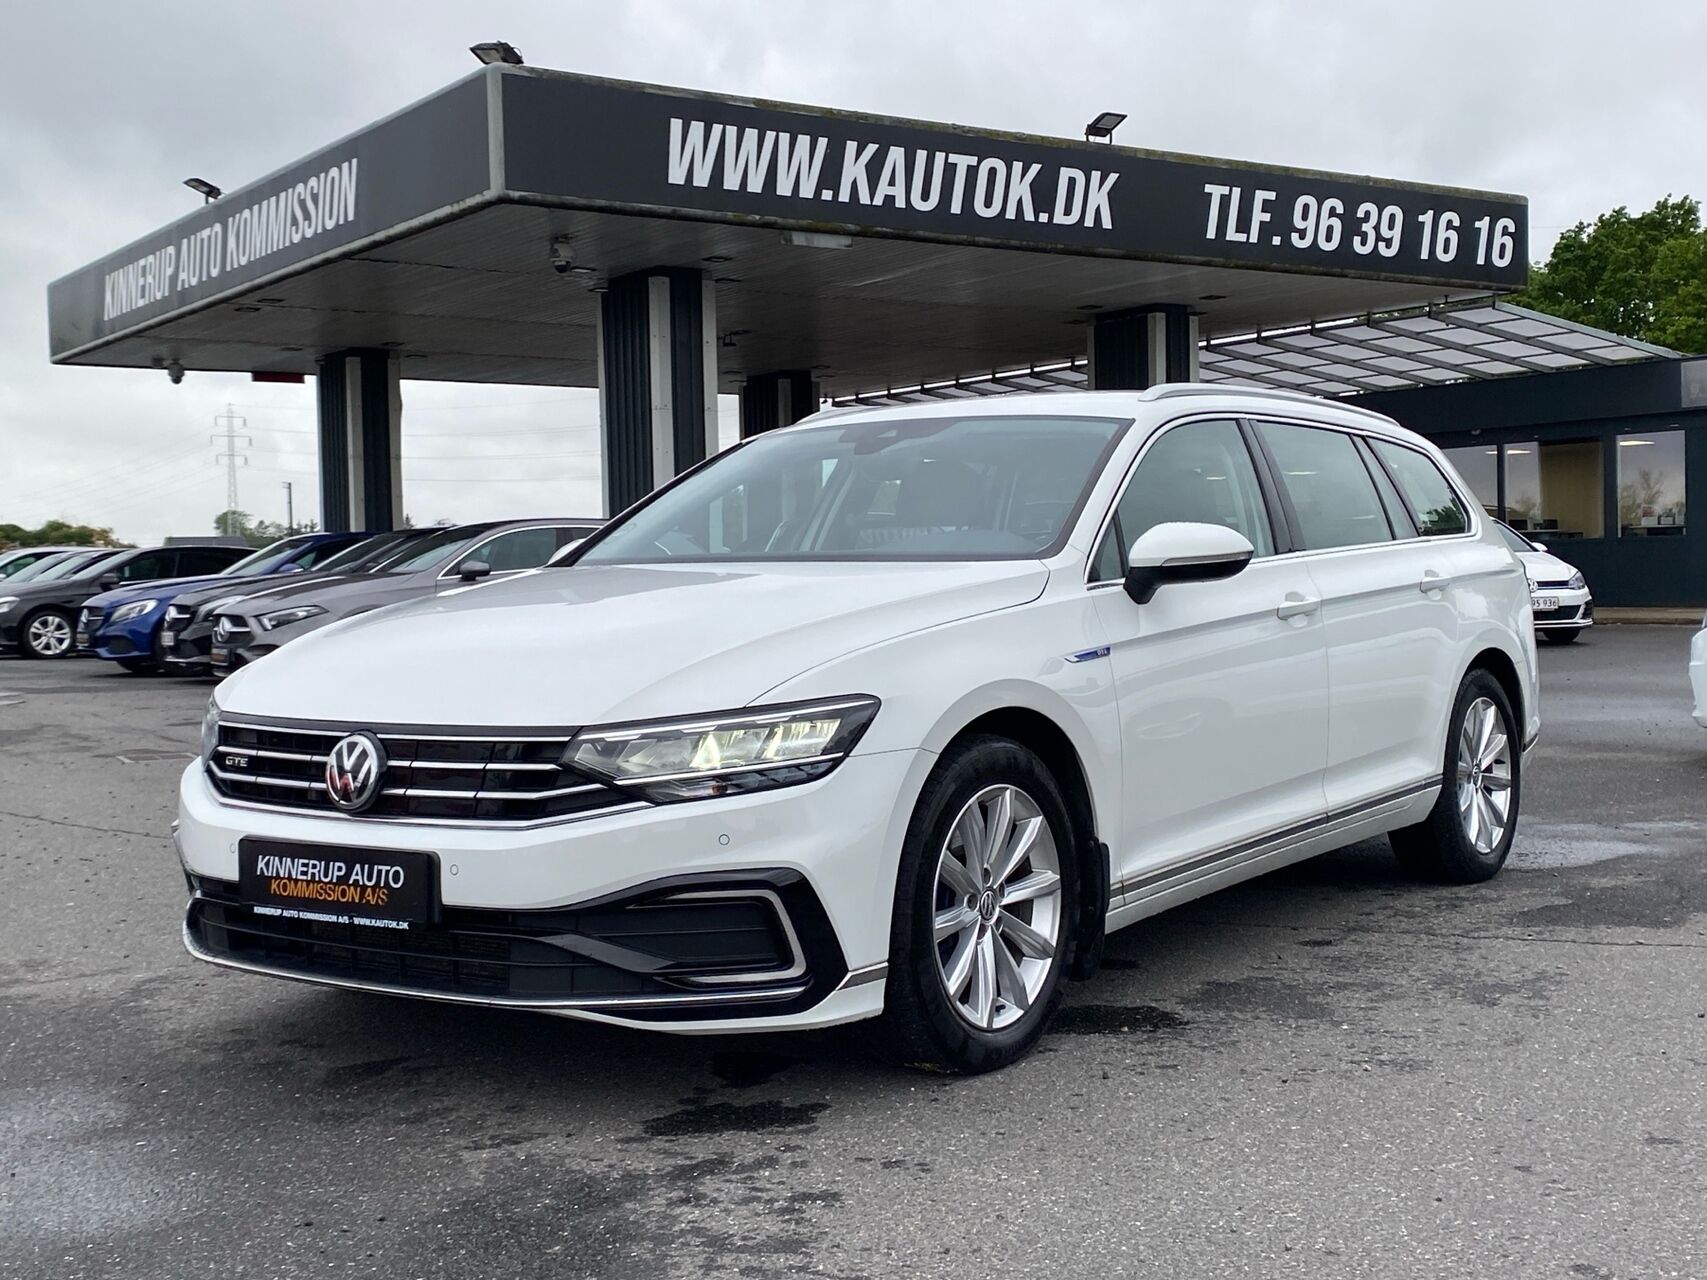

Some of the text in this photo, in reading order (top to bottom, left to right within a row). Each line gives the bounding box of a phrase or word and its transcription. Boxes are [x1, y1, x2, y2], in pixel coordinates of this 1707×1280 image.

[667, 117, 1121, 230] WWW.KAUTOK.DK
[103, 158, 358, 321] KINNERUP AUTO KOMMISSION
[1204, 183, 1516, 268] TLF. 96 39 16 16
[225, 755, 249, 767] GTE
[256, 855, 405, 888] KINNERUP AUTO
[270, 878, 389, 906] KOMMISSION A/S
[282, 909, 298, 918] AUTO
